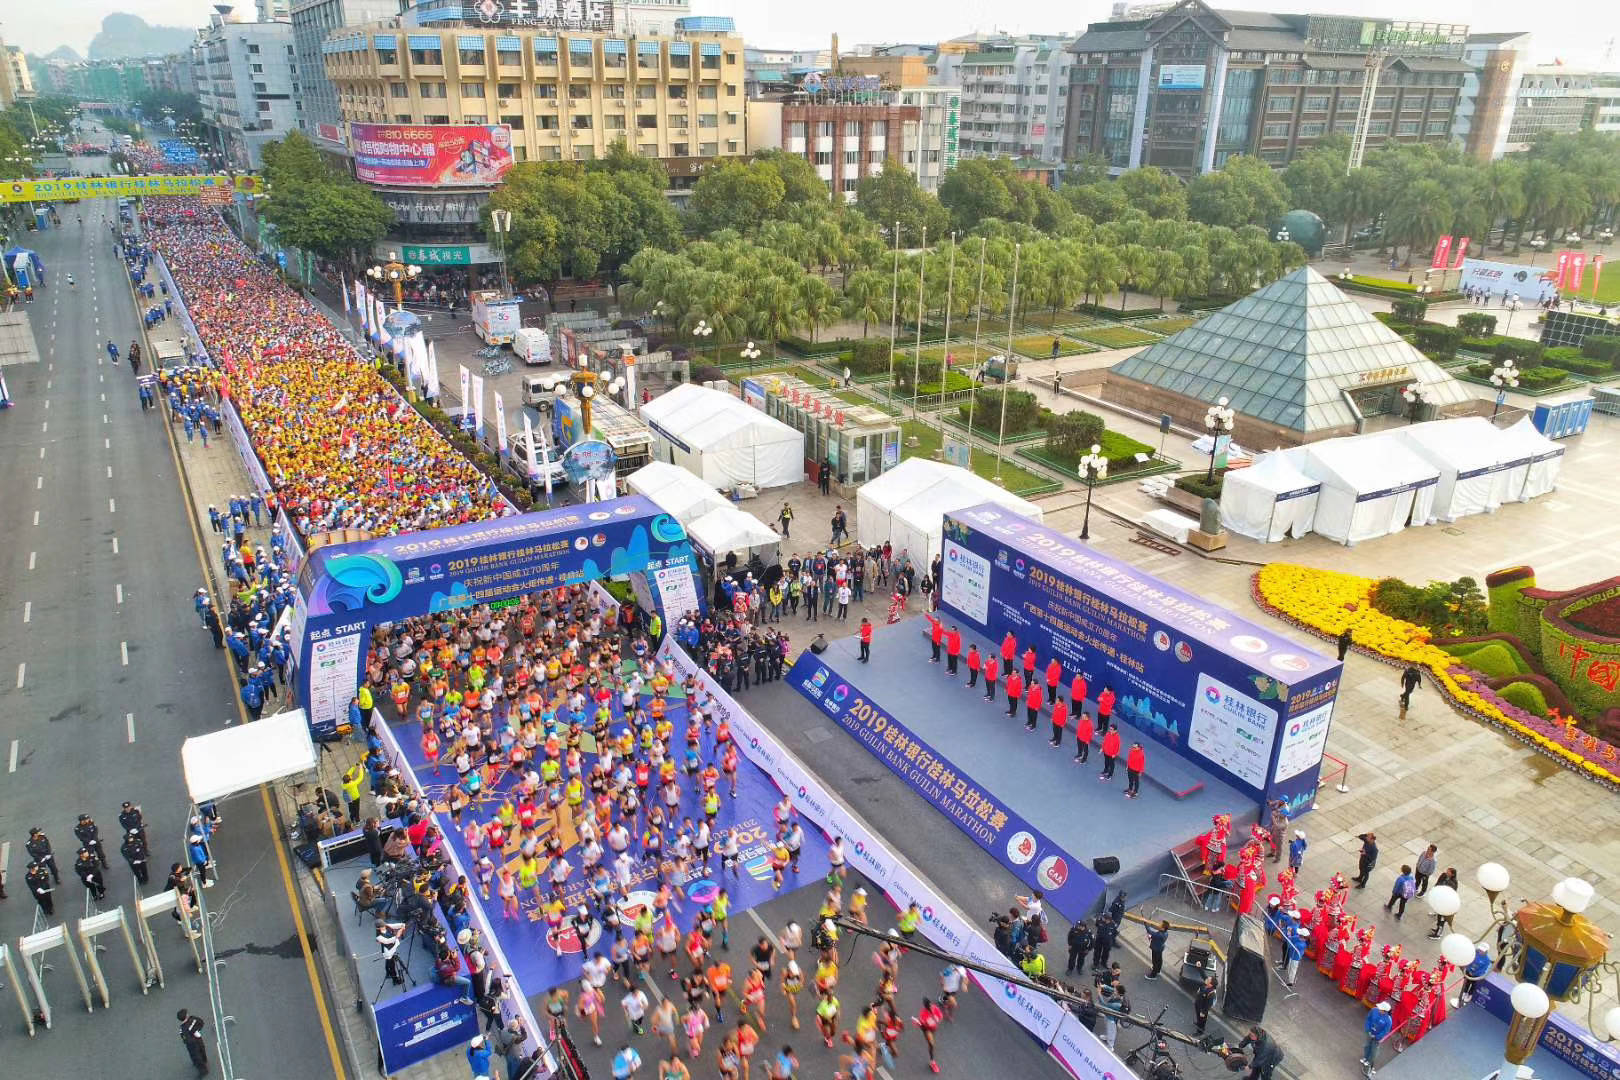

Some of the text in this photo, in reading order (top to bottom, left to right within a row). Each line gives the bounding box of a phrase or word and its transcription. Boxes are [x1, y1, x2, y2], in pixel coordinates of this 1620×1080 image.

[665, 555, 689, 566] START
[310, 621, 367, 640] 起点 START
[1224, 694, 1269, 725] 桂林银行
[842, 713, 996, 845] 2019 GUILIN BANK GUILIN MARATHON
[849, 698, 1009, 832] 2019桂林银行桂林马拉松赛
[932, 918, 961, 947] 桂林银行
[1017, 995, 1051, 1030] 桂林银行
[1062, 1034, 1103, 1076] GUILIN BANK
[1546, 1025, 1585, 1054] 2019
